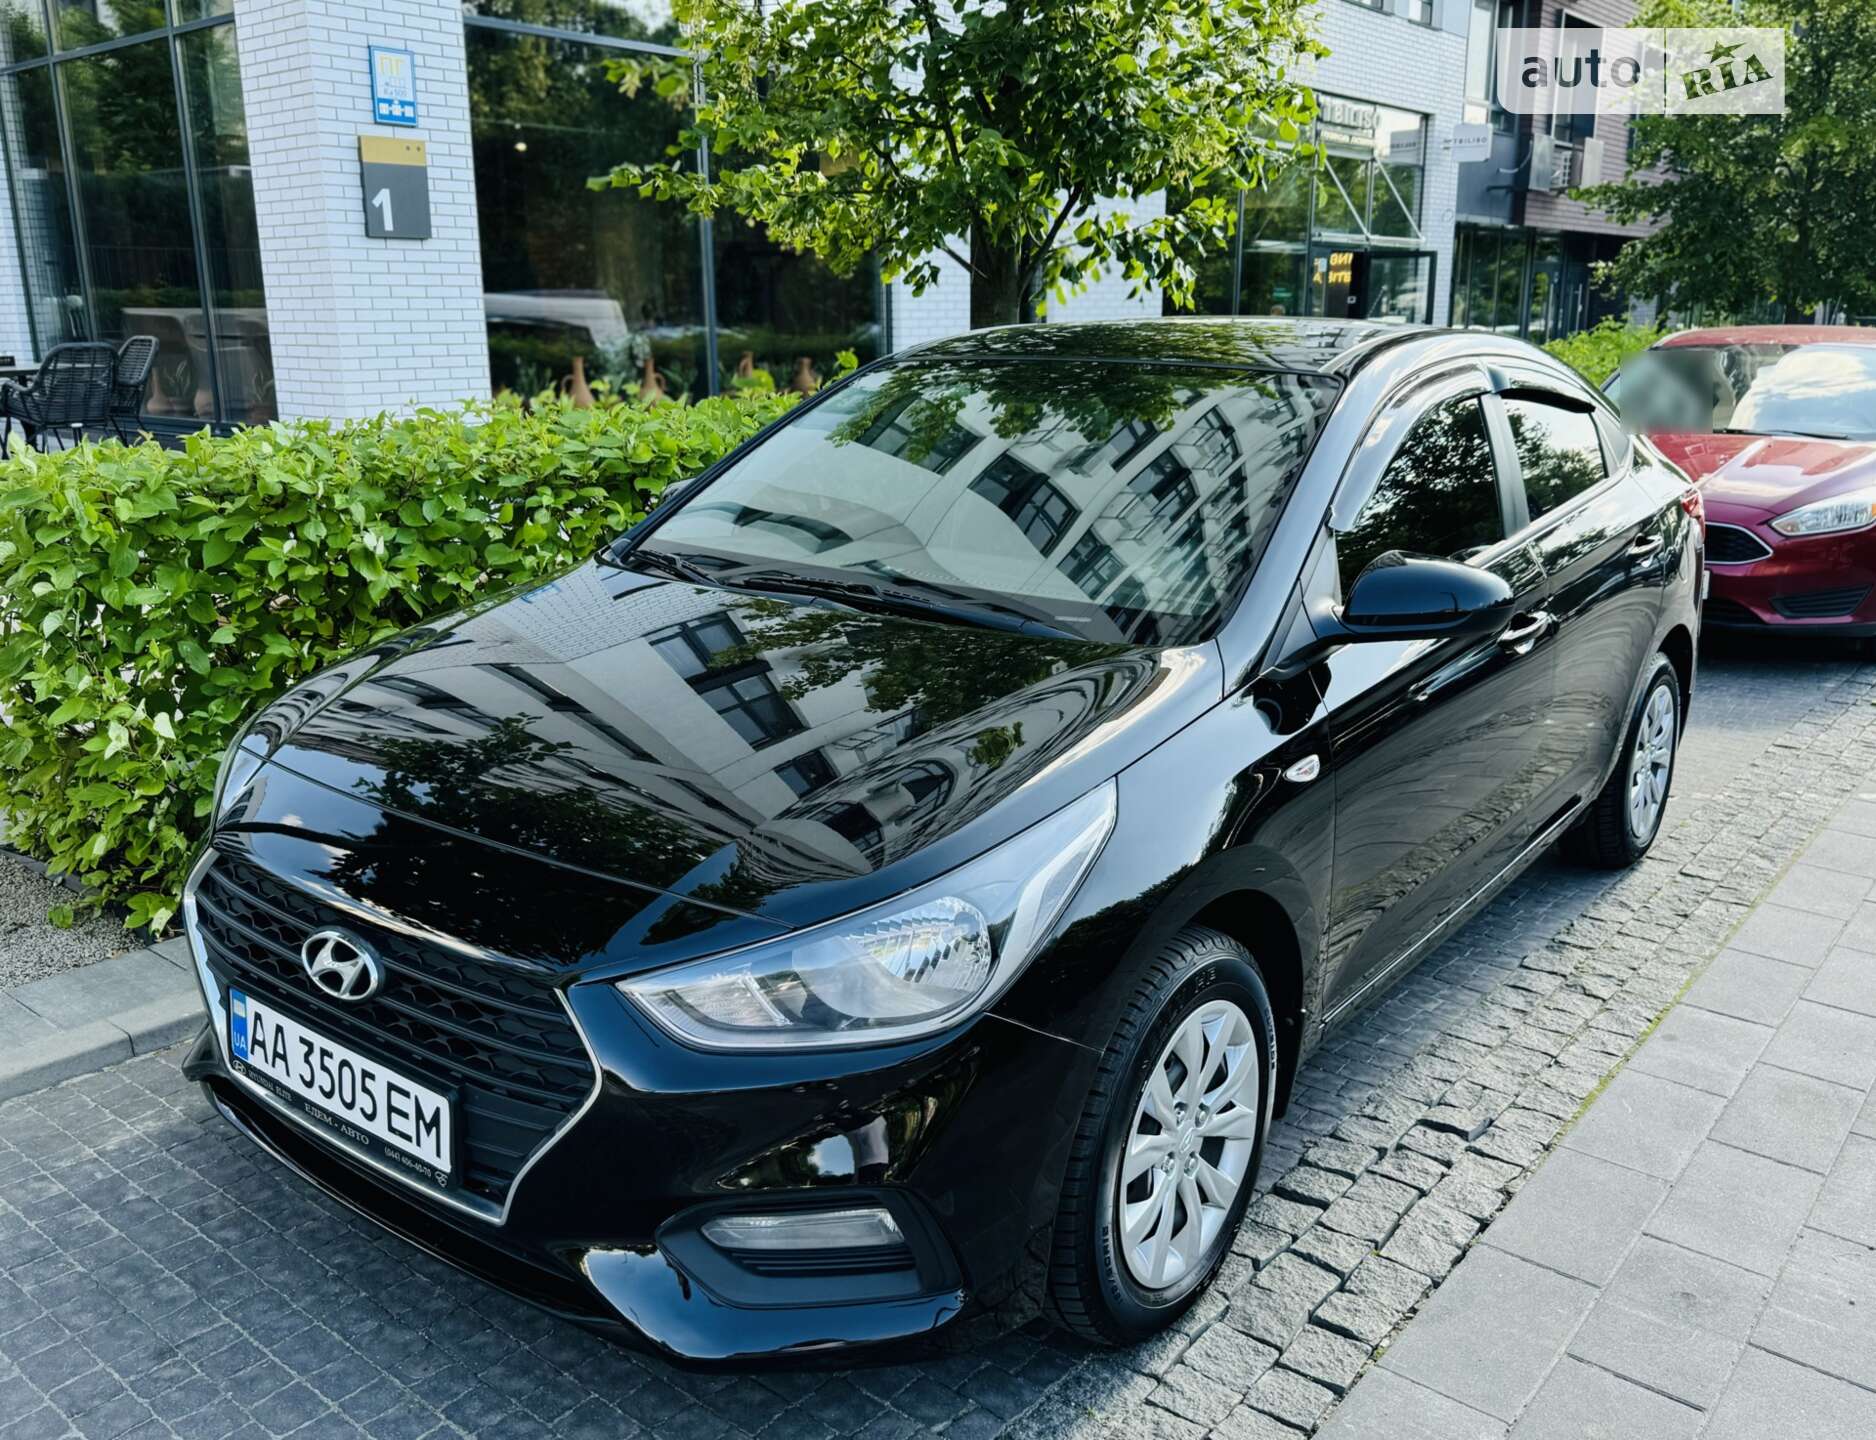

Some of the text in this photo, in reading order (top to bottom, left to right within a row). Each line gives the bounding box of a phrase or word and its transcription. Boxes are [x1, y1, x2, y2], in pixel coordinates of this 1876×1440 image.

[372, 188, 394, 231] 1
[233, 1031, 247, 1051] UA
[250, 1010, 442, 1160] AA 3505 EM
